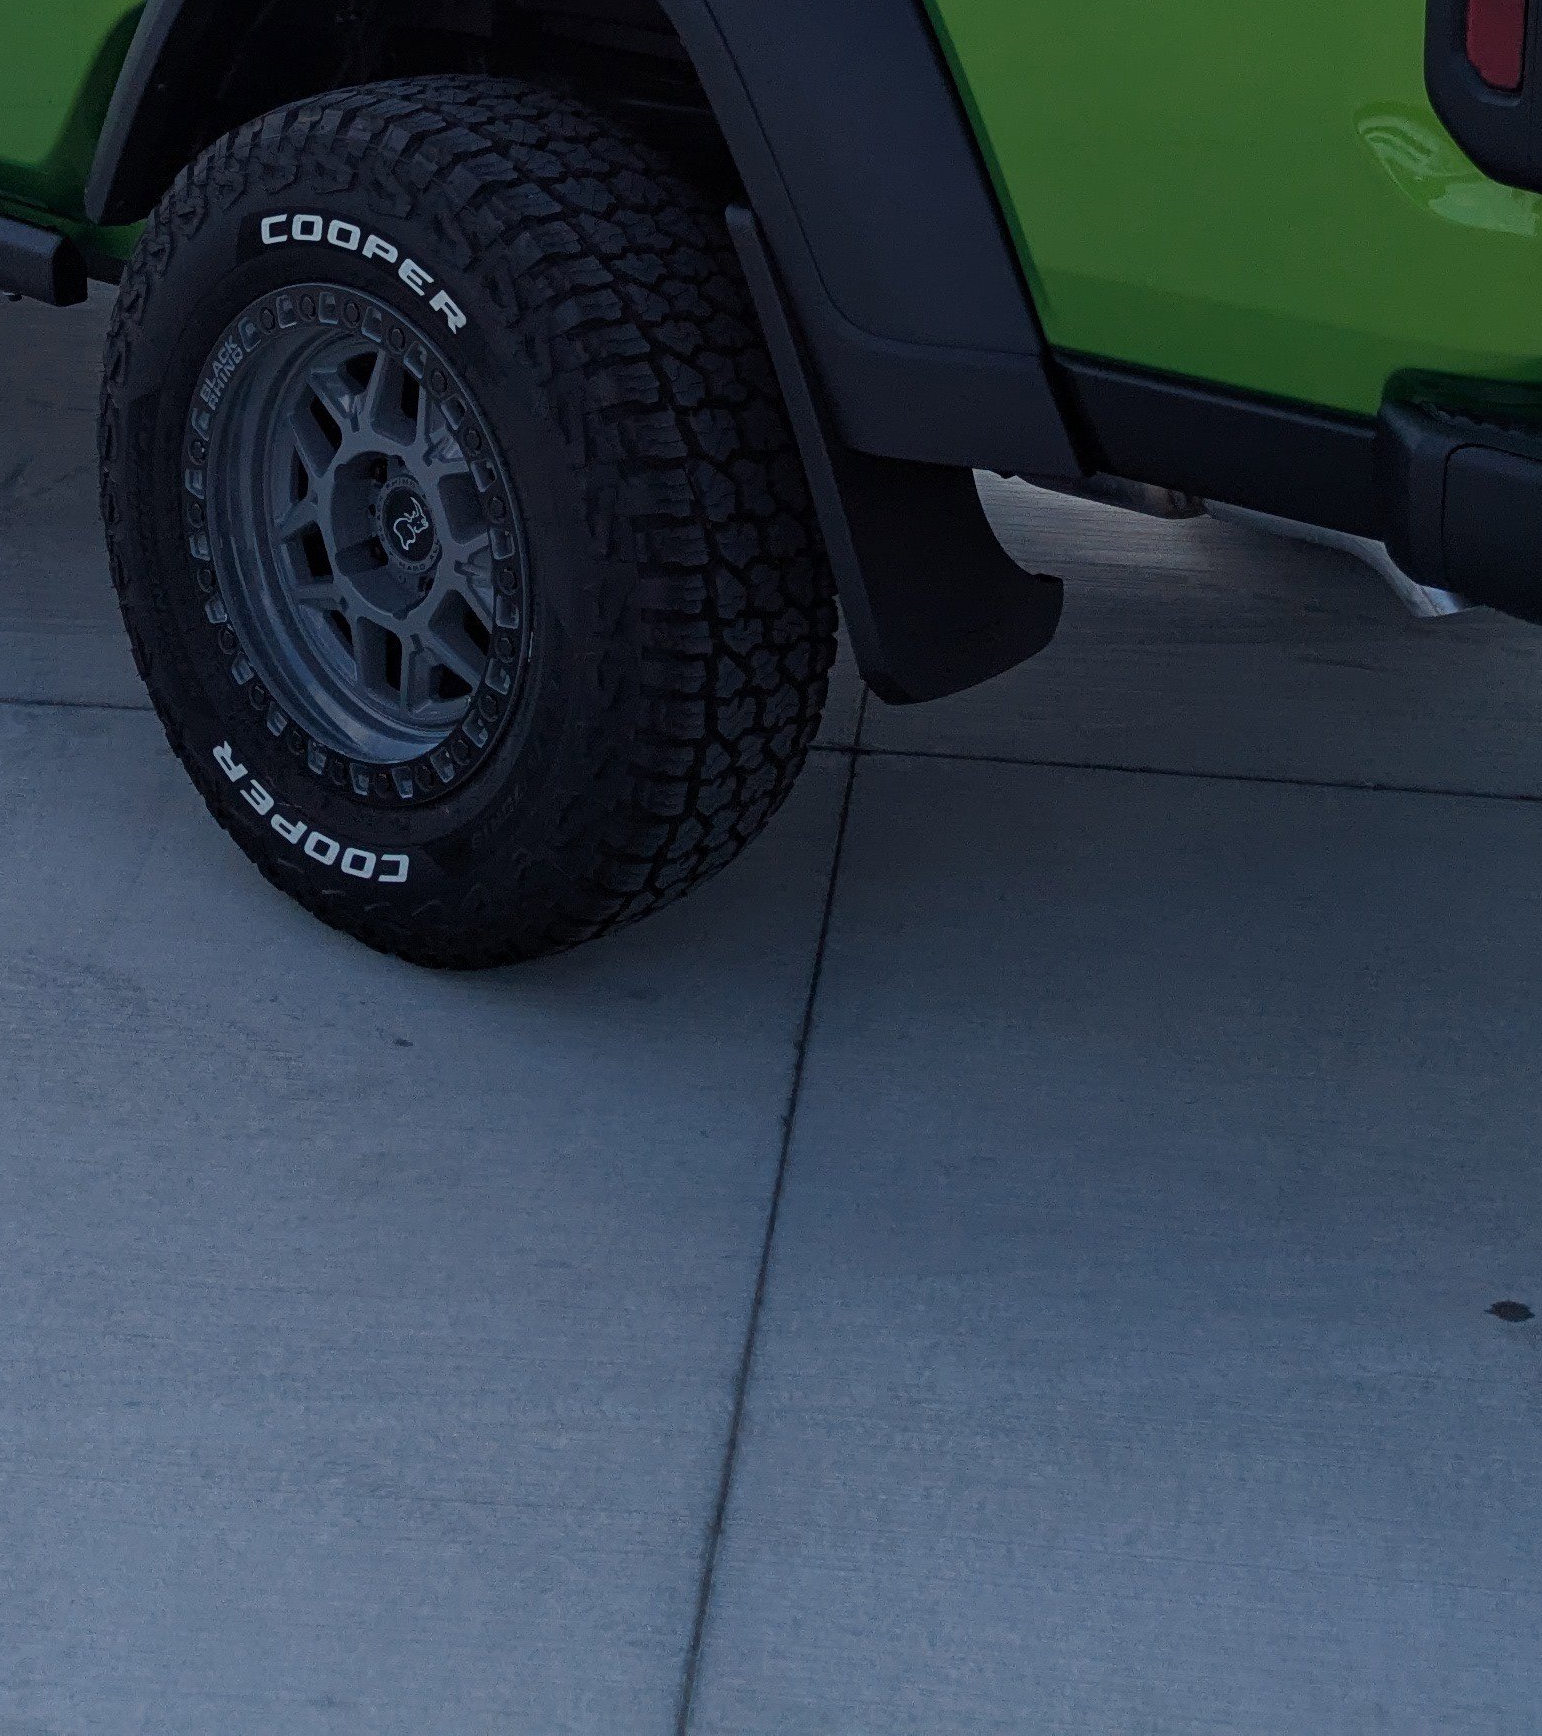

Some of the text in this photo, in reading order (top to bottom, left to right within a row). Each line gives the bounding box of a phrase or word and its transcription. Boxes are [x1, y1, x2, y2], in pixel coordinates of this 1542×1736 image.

[261, 213, 467, 335] COOPER
[199, 334, 239, 403] BLACK
[206, 346, 244, 412] RHINO
[212, 740, 410, 883] COOPER
